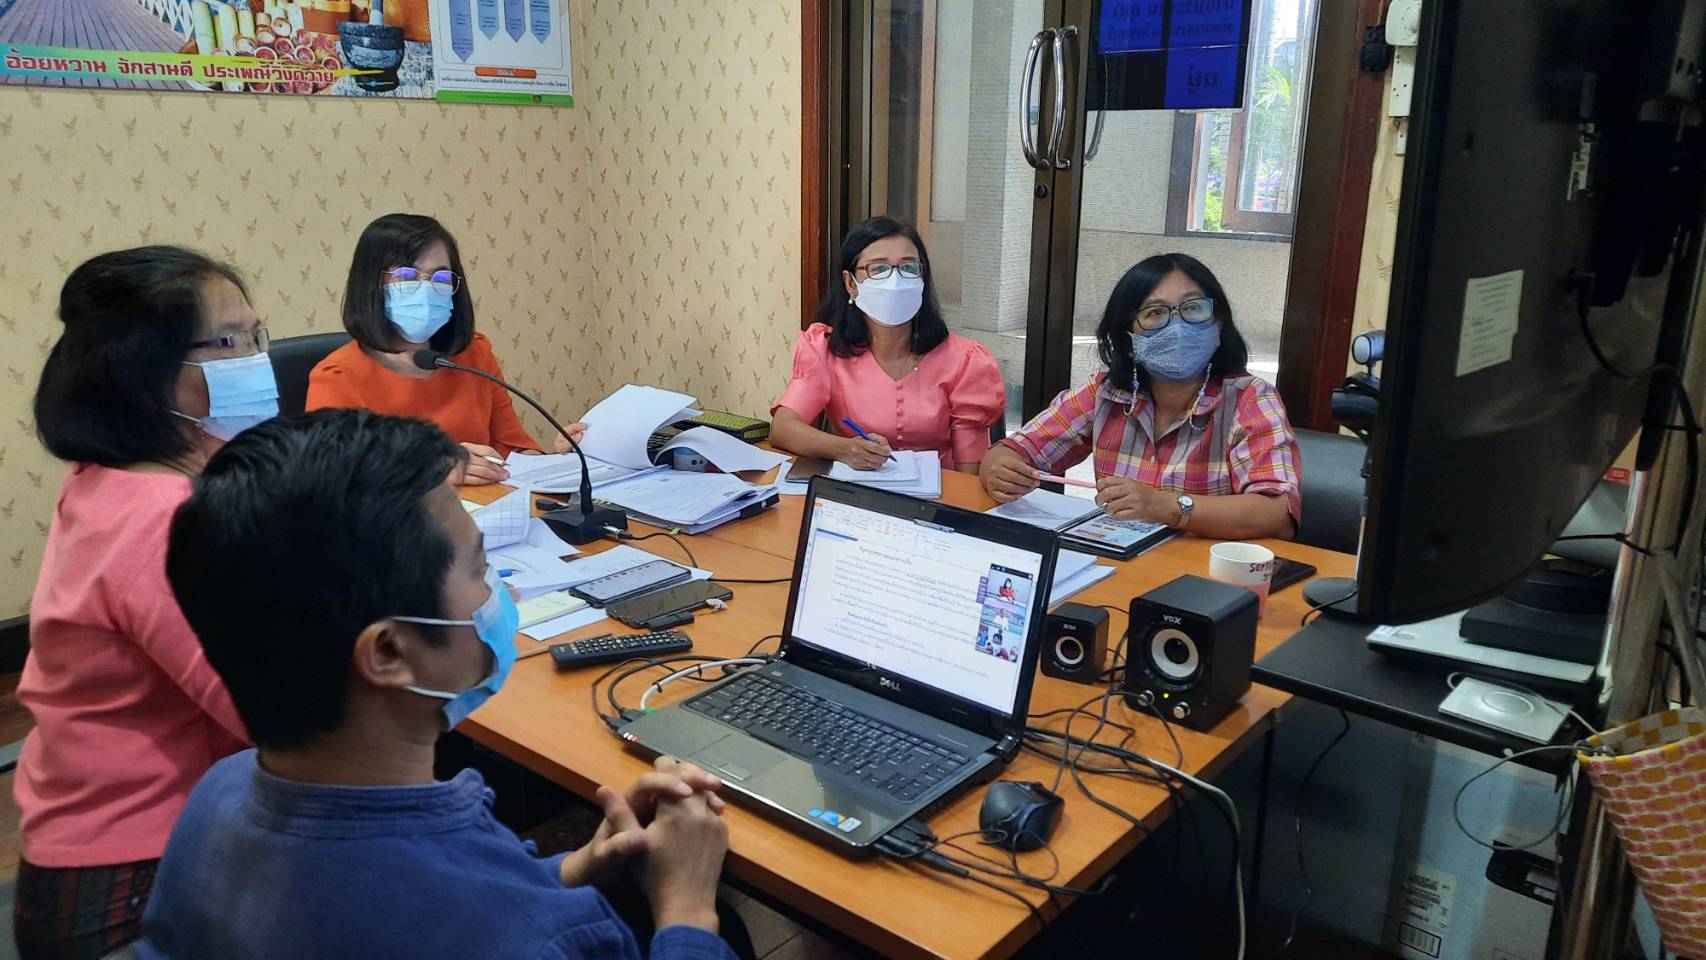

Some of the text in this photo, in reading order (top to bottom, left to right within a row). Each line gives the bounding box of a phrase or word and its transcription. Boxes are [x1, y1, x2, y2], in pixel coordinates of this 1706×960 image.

[5, 47, 108, 73] อ้อยหวาน
[117, 57, 194, 77] จักสานดี
[880, 676, 901, 691] DELL
